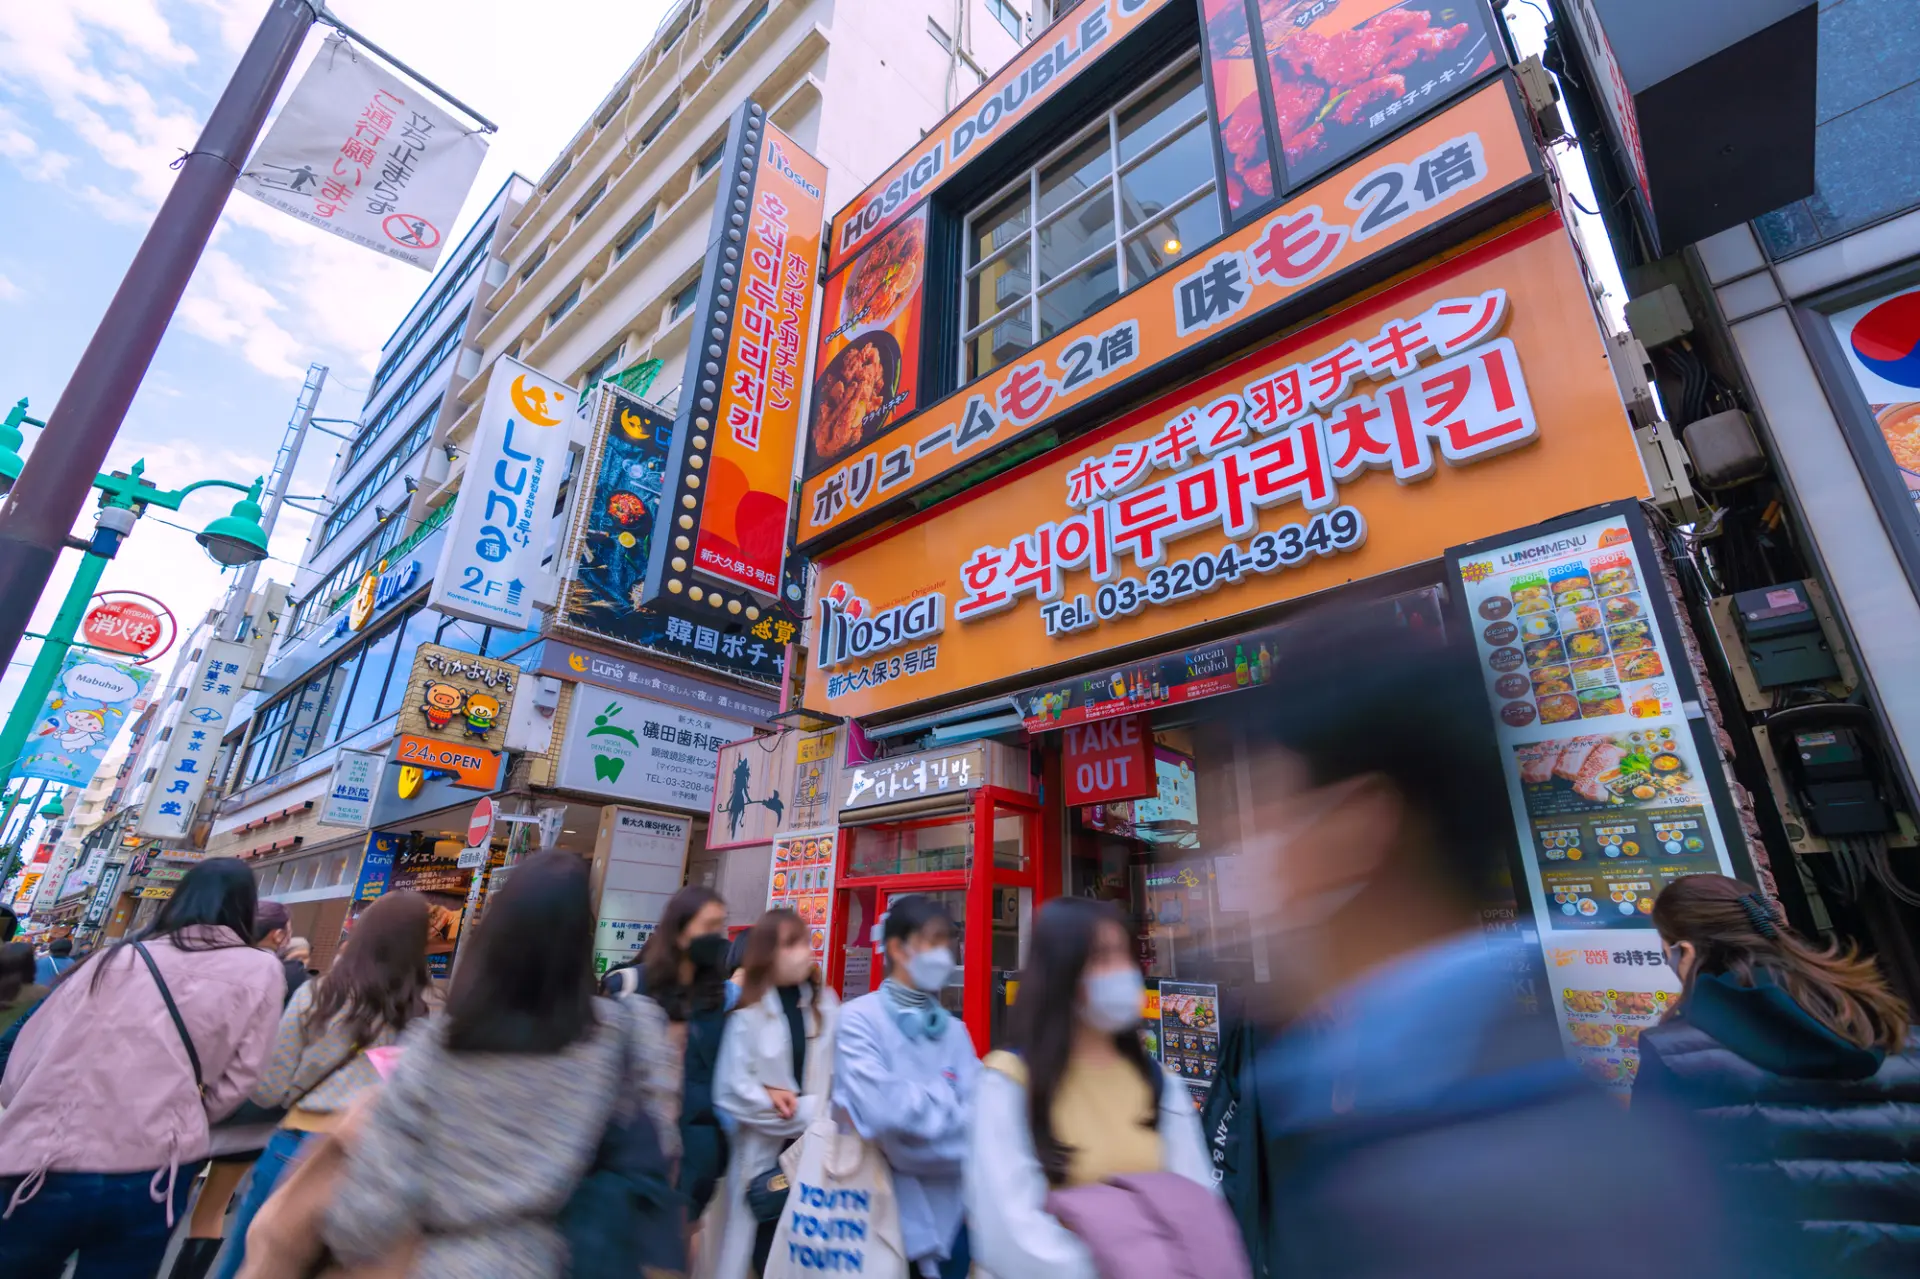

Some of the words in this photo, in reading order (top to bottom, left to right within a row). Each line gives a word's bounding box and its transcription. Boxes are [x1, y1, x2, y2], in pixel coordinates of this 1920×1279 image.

[1369, 58, 1474, 129] 唐辛子チキン
[842, 148, 942, 251] HOSIGI
[953, 5, 1107, 158] DOUBLE
[314, 88, 406, 218] ご通行願います
[366, 110, 435, 215] 立ち止まらず
[768, 140, 821, 200] HOSIGI
[730, 192, 788, 450] 호식이두마리치킨
[812, 326, 1133, 523] ボリュームも2倍
[1181, 141, 1476, 330] 味も2倍
[863, 390, 910, 425] フライドチキン
[1071, 297, 1498, 502] ホシギ2羽チキン
[476, 418, 532, 562] Luna
[959, 348, 1523, 613] 호식이두마리치킨
[700, 548, 776, 587] 新大久保3号店
[1043, 596, 1090, 633] Tel.
[1098, 512, 1359, 617] 03-3204-3349
[1548, 560, 1583, 577] 880円
[1590, 550, 1627, 567] 980円
[460, 565, 503, 597] 2F
[89, 611, 156, 646] 消火栓
[105, 604, 121, 614] FIRE
[123, 606, 155, 621] HYDRANT
[820, 597, 936, 666] HOSIGI
[592, 659, 624, 679] Luna
[827, 646, 938, 699] 新大久保3号店
[1185, 648, 1225, 664] Korean
[1186, 657, 1229, 678] Alcohol
[76, 674, 124, 693] Mabuhay
[201, 659, 222, 692] 洋菓子
[216, 662, 240, 695] 喫茶
[1084, 680, 1107, 692] Beer
[678, 715, 713, 729] 新大久保
[1065, 715, 1141, 756] TAKE
[188, 730, 206, 751] 東京
[401, 741, 437, 762] 24h
[439, 751, 482, 770] OPEN
[337, 784, 369, 798] 林医院
[875, 758, 971, 799] 마녀김밥
[1076, 756, 1132, 794] OUT
[622, 816, 681, 832] 新大久保SHKビル
[367, 855, 393, 865] Luna
[1483, 909, 1514, 919] OPEN
[1586, 957, 1609, 965] OUT
[1214, 1100, 1238, 1146] DEAN
[1213, 1148, 1224, 1162] &
[799, 1182, 870, 1212] YOUTH
[791, 1211, 867, 1241] YOUTH
[788, 1241, 864, 1273] YOUTH
